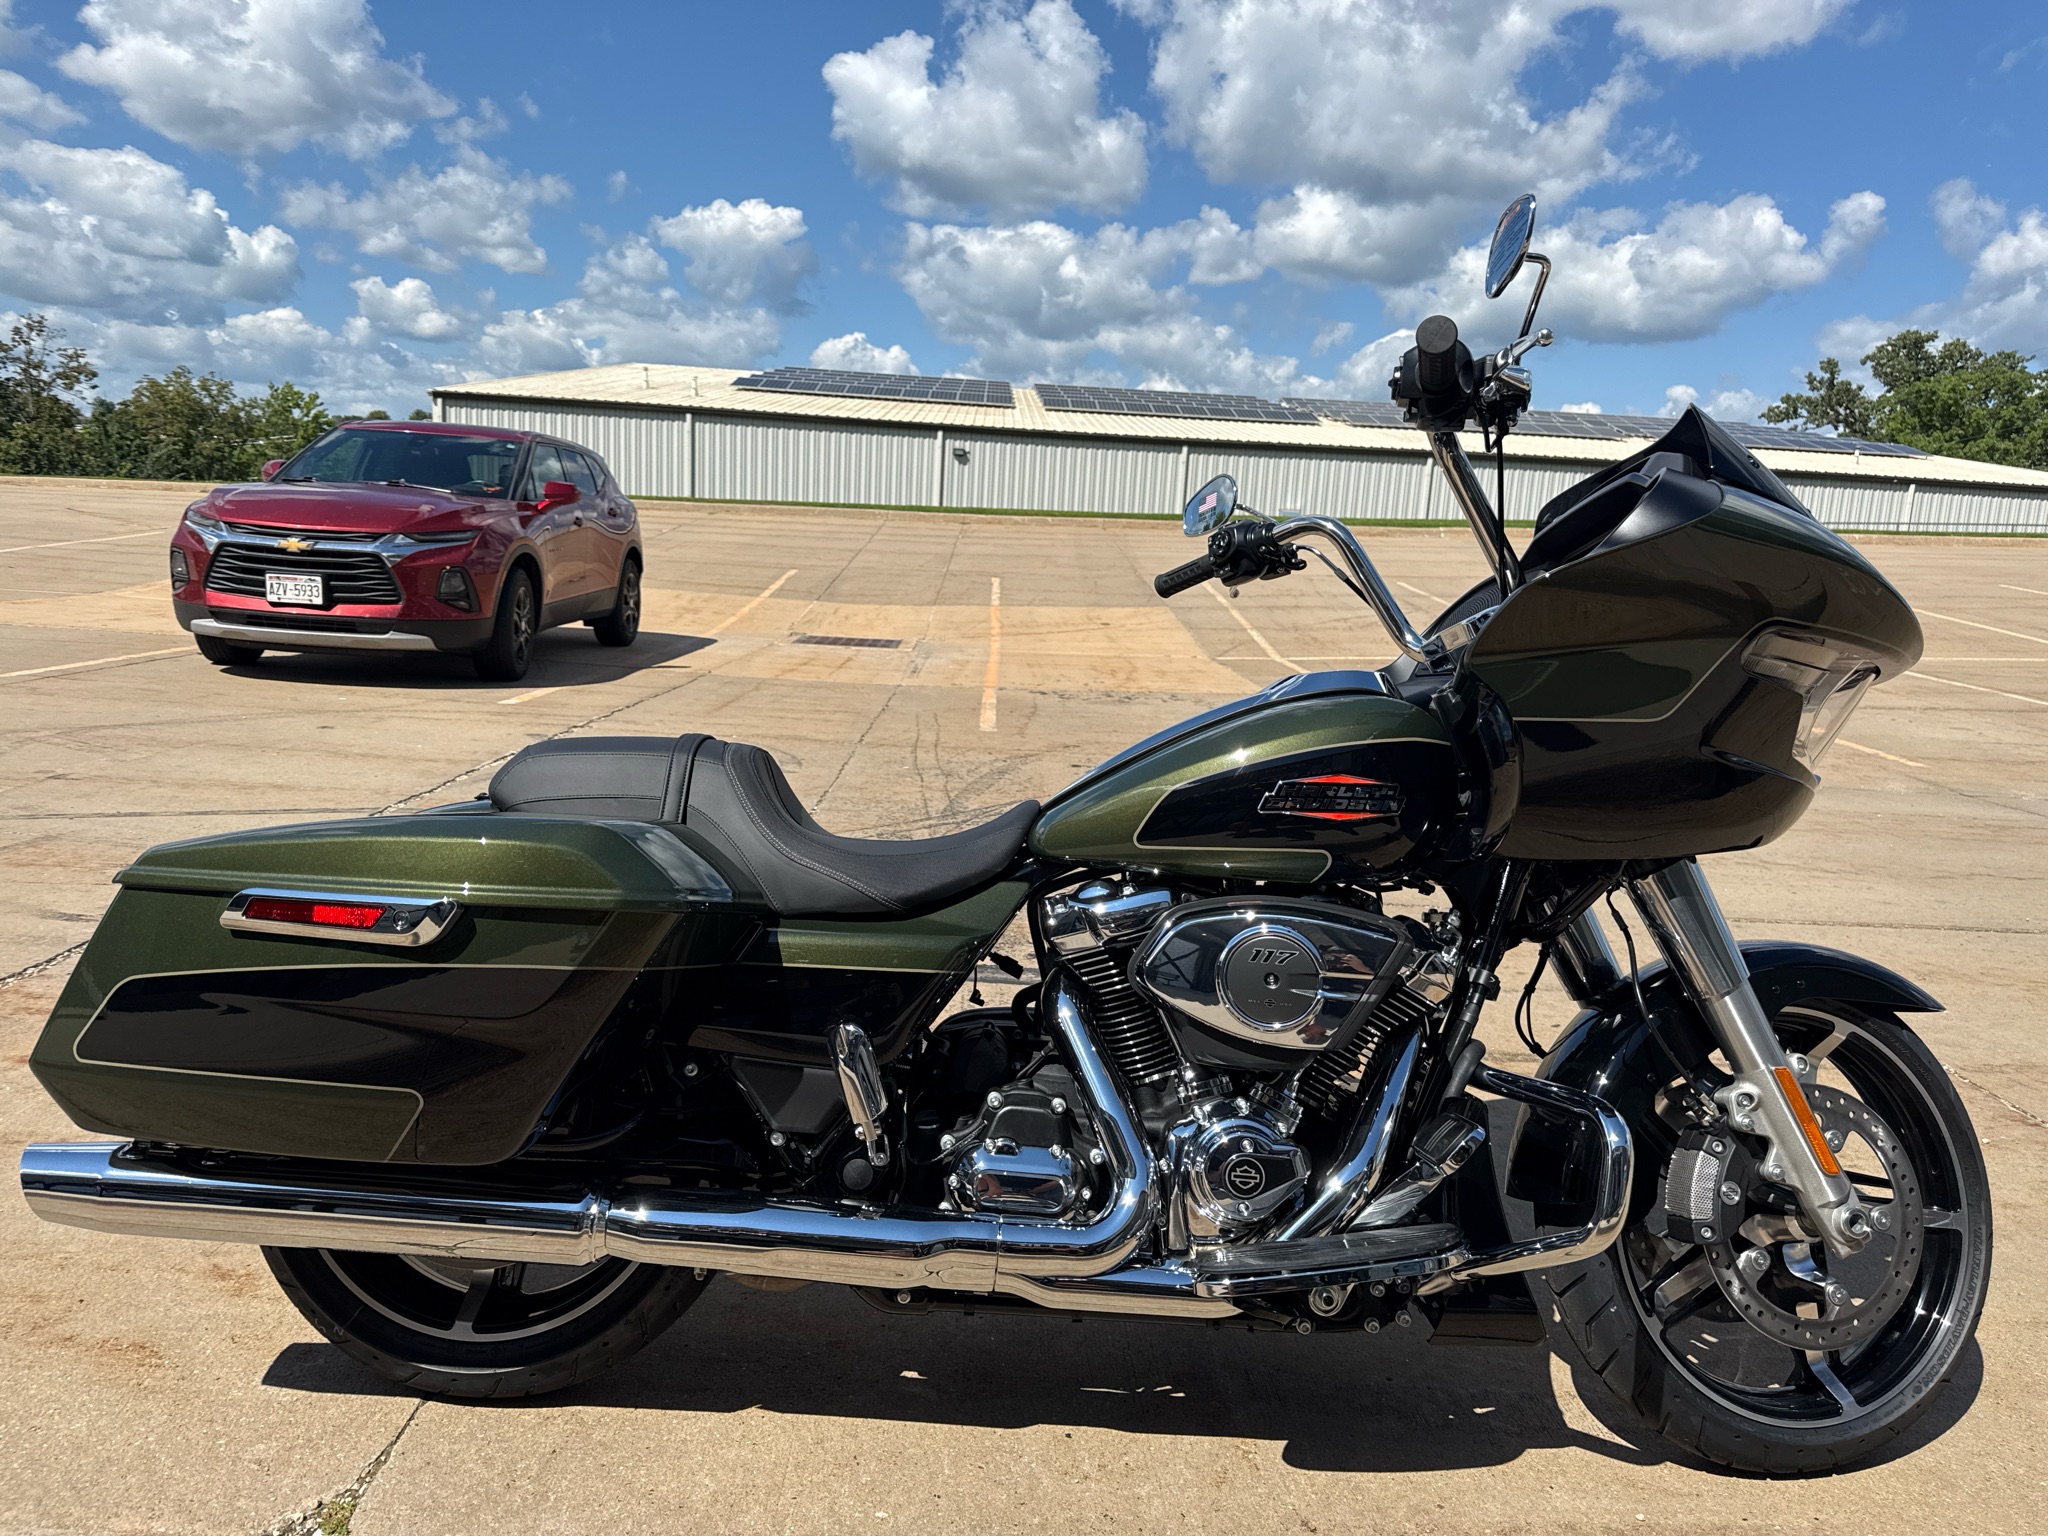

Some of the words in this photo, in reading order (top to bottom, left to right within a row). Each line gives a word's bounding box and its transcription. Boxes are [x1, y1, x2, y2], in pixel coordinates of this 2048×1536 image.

[269, 582, 320, 598] AZV-5933
[1279, 785, 1395, 798] HARLEY-
[1264, 797, 1399, 811] DAVIDSON
[1248, 947, 1299, 966] 117
